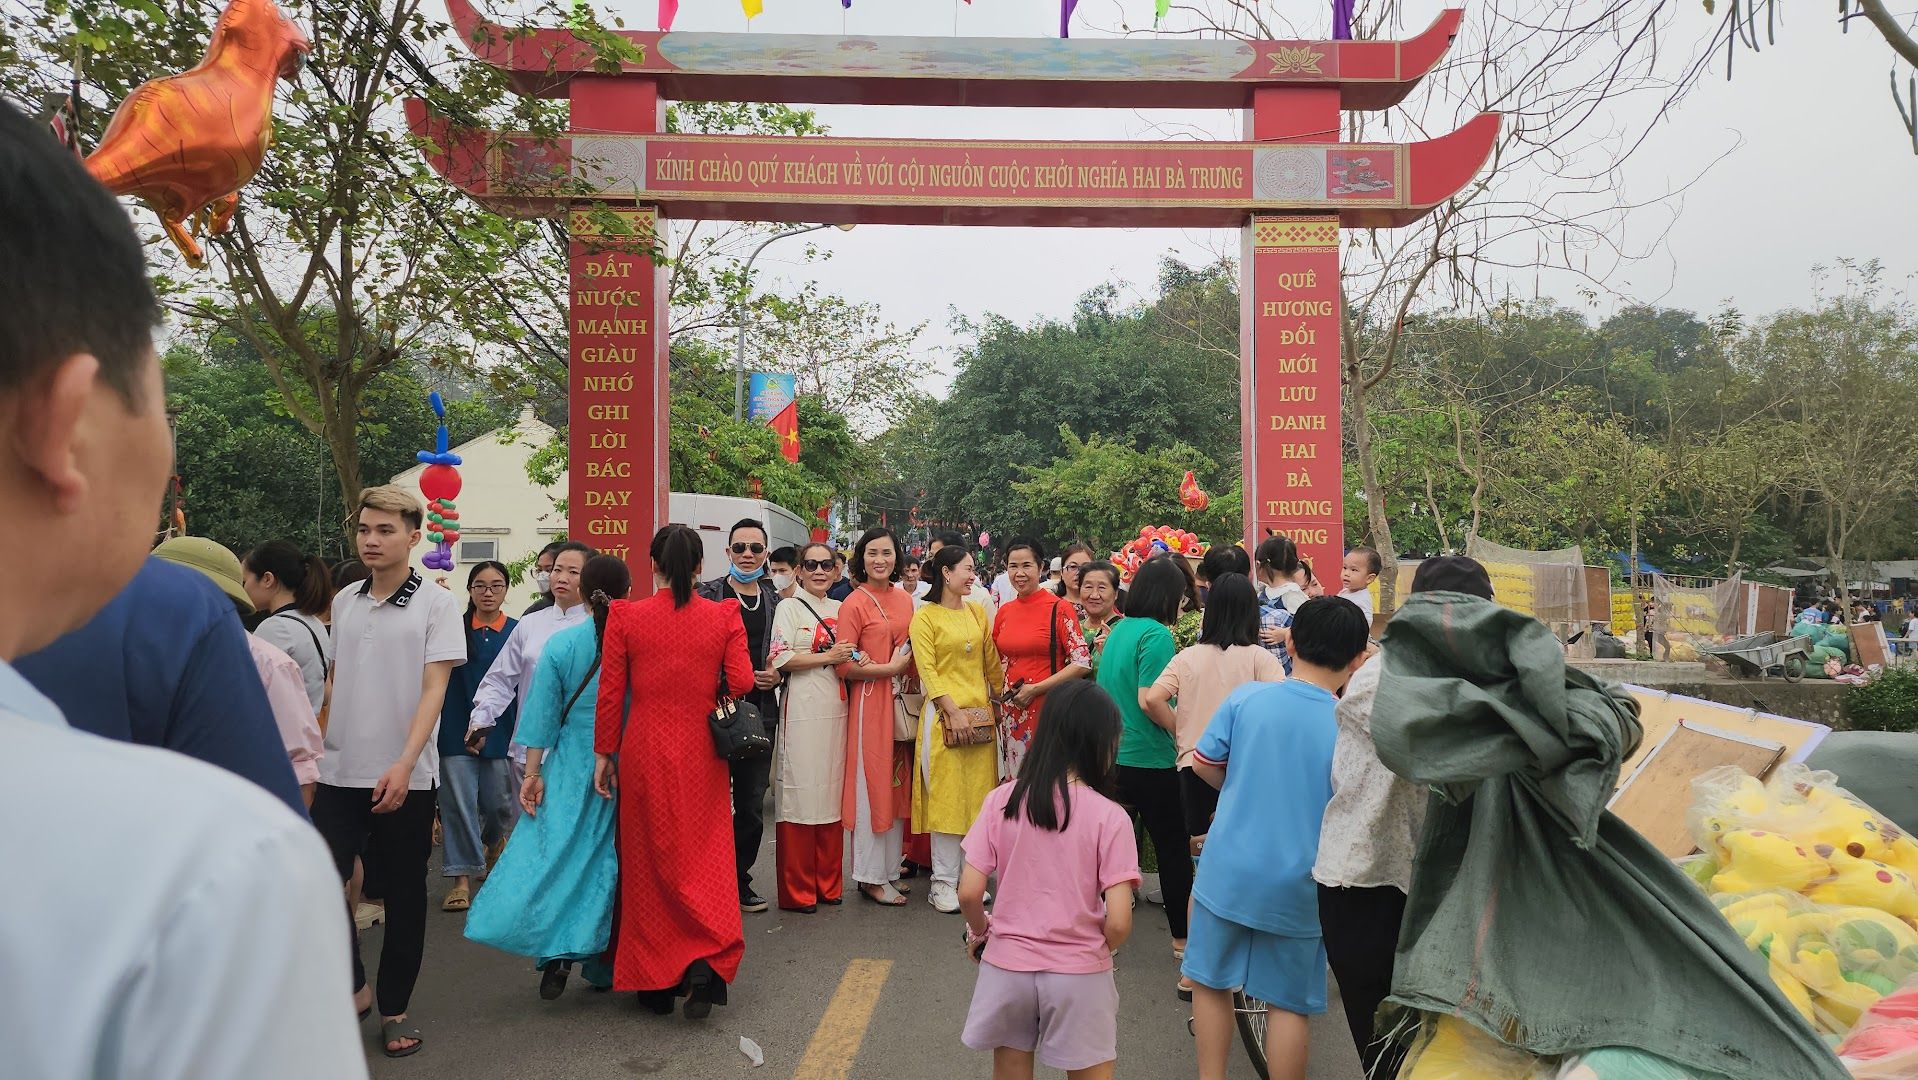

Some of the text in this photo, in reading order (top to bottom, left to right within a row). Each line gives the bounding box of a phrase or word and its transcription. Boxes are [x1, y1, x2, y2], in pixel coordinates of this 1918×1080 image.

[656, 150, 1243, 194] KÍNH CHÀO QUÝ KHÁCH VỀ VỚI CỘI NGUỒN CUỘC KHỞI NGHĨA HAI BÀ TRƯNG
[586, 254, 632, 278] ĐẤT
[1278, 269, 1317, 291] QUÊ
[577, 286, 641, 307] NƯỚC
[1263, 300, 1333, 317] HƯƠNG
[577, 319, 647, 339] MẠNH
[1280, 322, 1315, 345] ĐỔI
[581, 343, 637, 363] GIÀU
[1278, 353, 1318, 374] MỚI
[583, 371, 634, 392] NHỚ
[1279, 386, 1317, 402] LƯU
[587, 405, 630, 420] GHI
[1270, 415, 1327, 431] DANH
[590, 428, 627, 449] LỜI
[1281, 443, 1317, 459] HAI
[586, 457, 631, 478] BÁC
[1286, 467, 1313, 488] BÀ
[585, 491, 632, 510] DẠY
[1266, 499, 1333, 516] TRƯNG
[588, 515, 629, 535] GÌN
